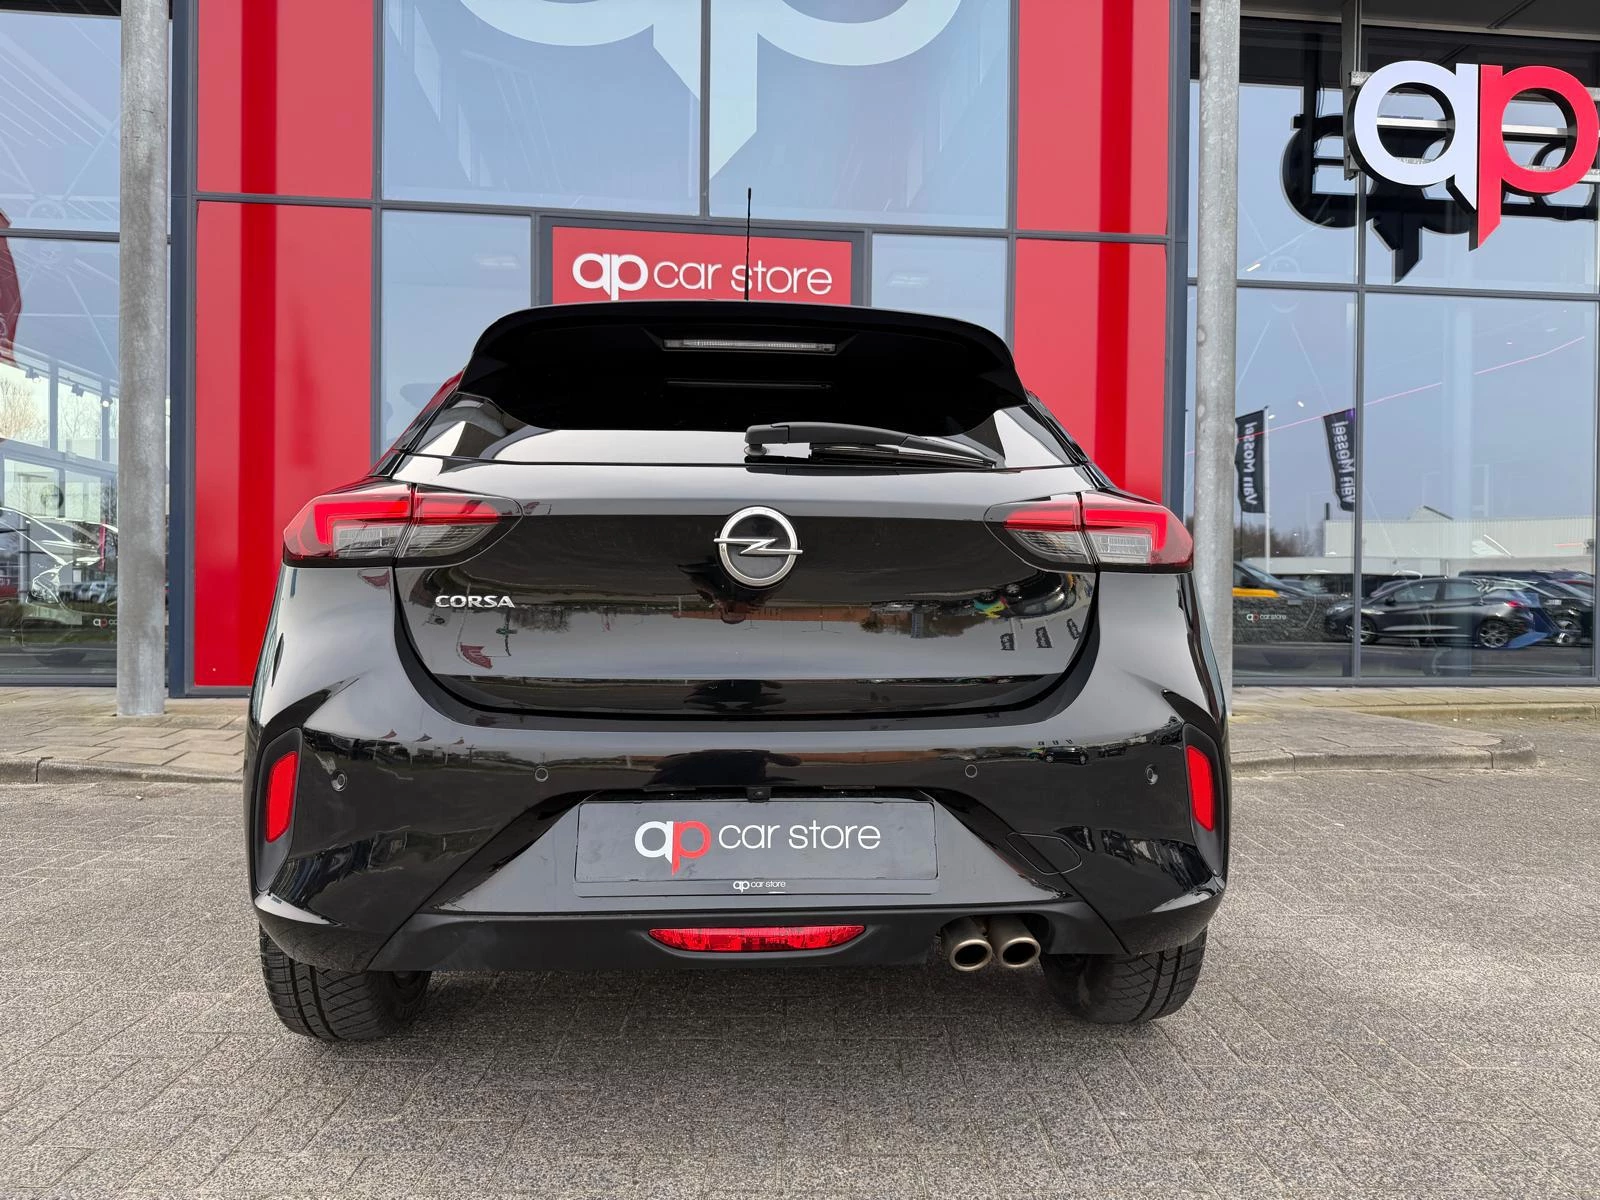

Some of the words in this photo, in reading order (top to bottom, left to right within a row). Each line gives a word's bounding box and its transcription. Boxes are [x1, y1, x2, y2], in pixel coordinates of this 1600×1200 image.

[653, 261, 722, 290] car
[731, 260, 832, 295] store
[435, 595, 516, 609] CORSA
[718, 824, 781, 849] car
[788, 819, 881, 850] store
[765, 880, 786, 888] store
